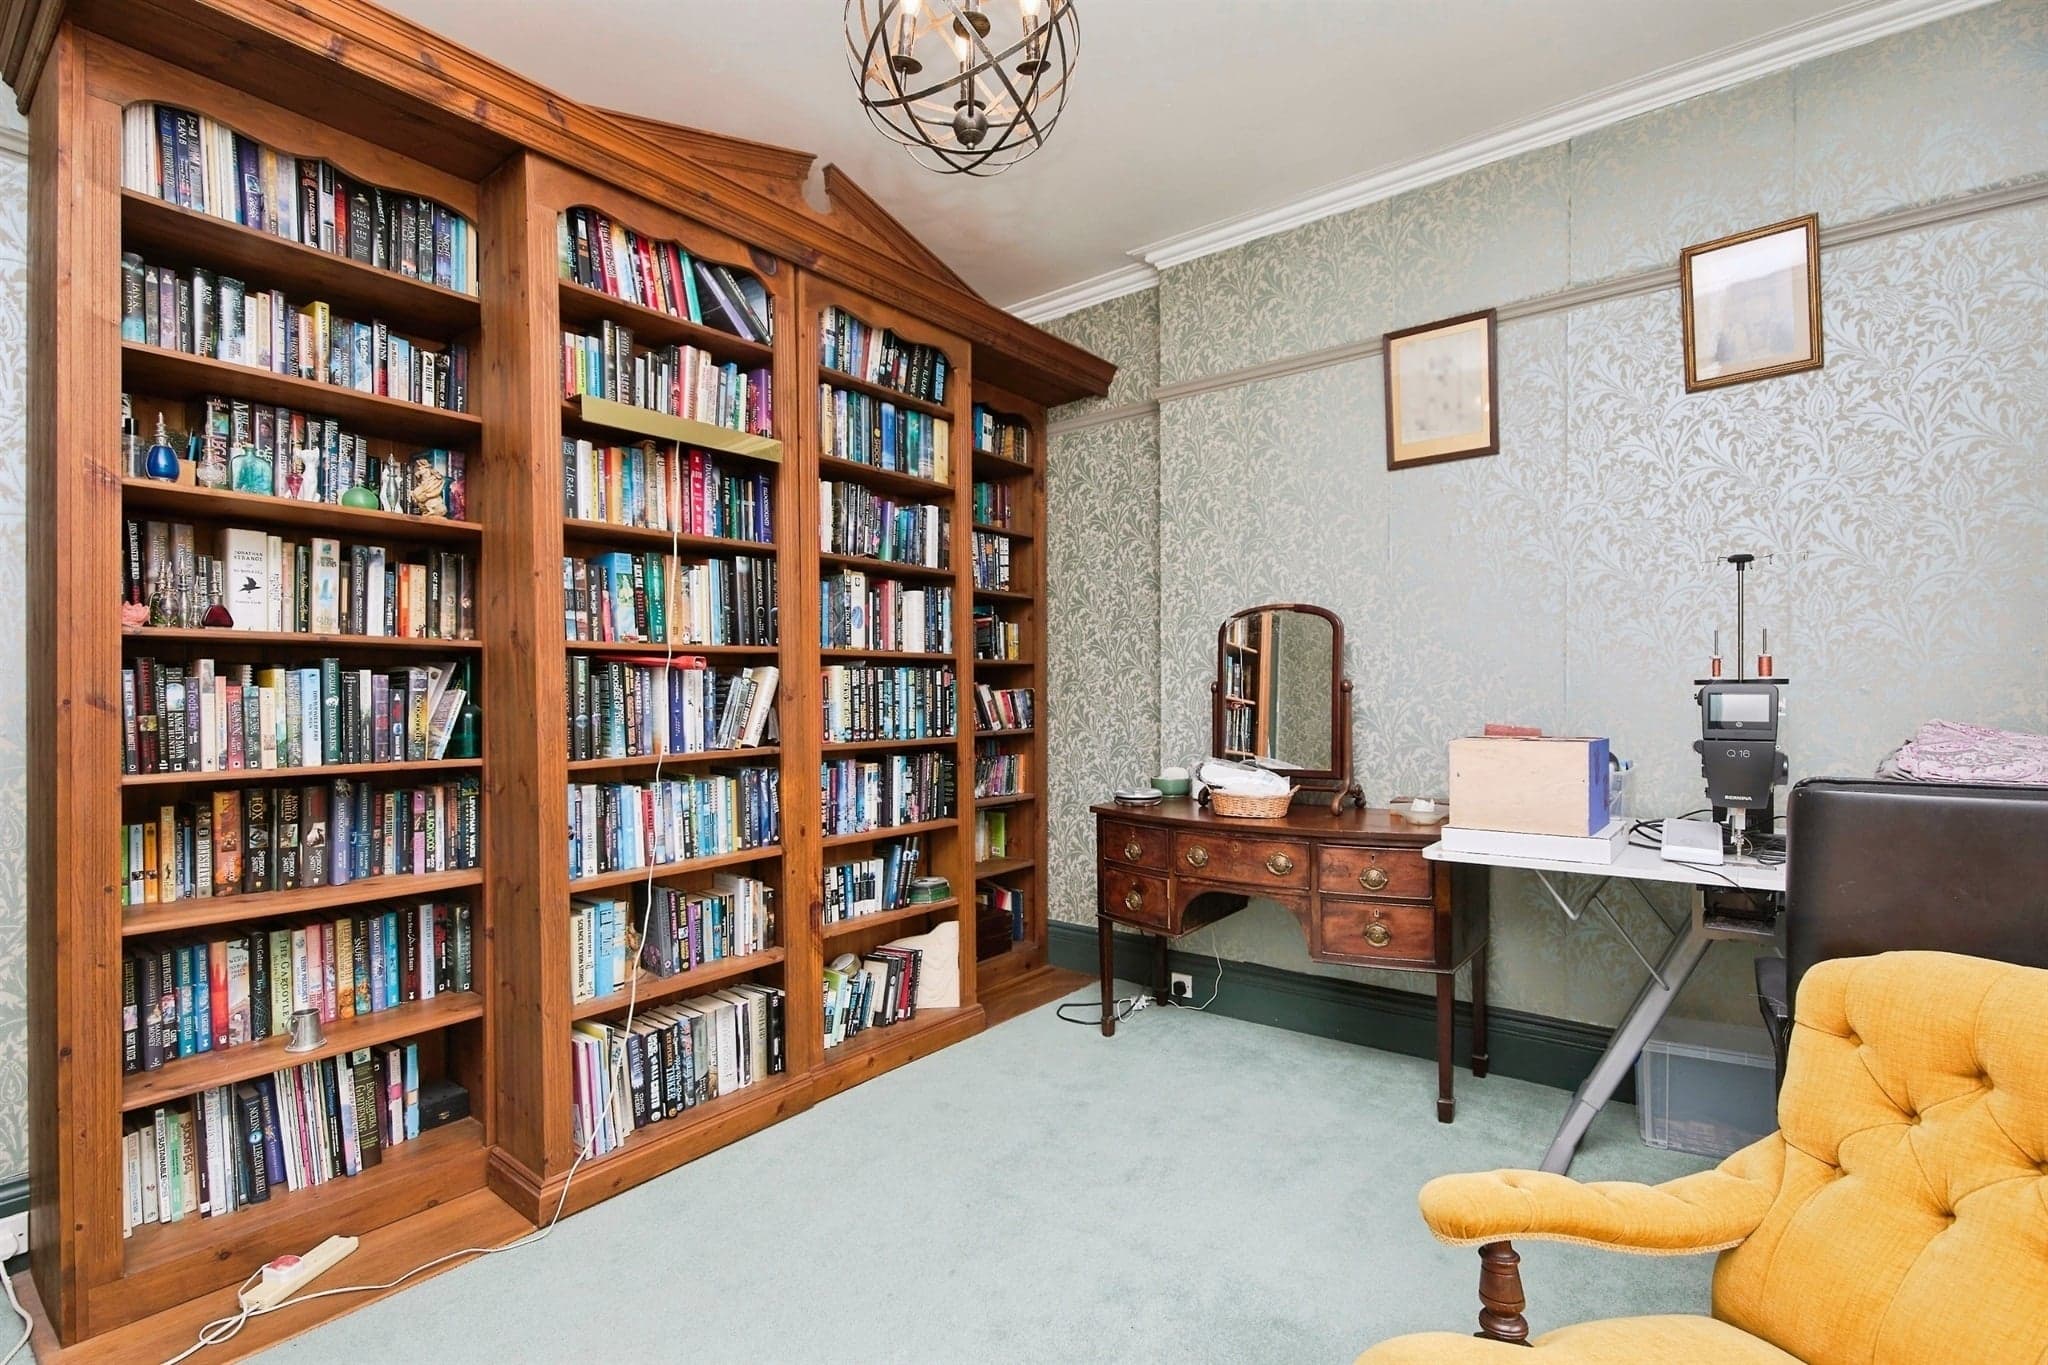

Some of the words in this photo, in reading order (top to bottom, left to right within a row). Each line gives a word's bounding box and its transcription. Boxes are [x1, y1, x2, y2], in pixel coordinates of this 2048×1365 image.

[210, 436, 226, 485] LEGAC
[612, 665, 620, 700] CHOOSERS
[745, 684, 756, 707] LOVECRAFT
[188, 689, 198, 712] Tooth
[188, 712, 198, 729] Fairy
[168, 730, 176, 760] HUNTER
[1726, 750, 1736, 758] Q
[1739, 750, 1750, 758] 16
[252, 796, 263, 820] FOX
[284, 795, 292, 821] SHIELD
[426, 810, 435, 852] BLACKWOOD
[198, 840, 210, 888] BONESHAKER
[280, 937, 288, 959] THE
[354, 938, 362, 962] SNUFF
[280, 961, 290, 1016] GARGOYLE
[666, 1068, 676, 1101] TINKER
[248, 1107, 260, 1132] NATION
[355, 1085, 366, 1132] GARDENING
[366, 1082, 376, 1128] ENCYCLOPEDIA
[158, 1136, 168, 1179] SUSTAINABLE
[253, 1144, 264, 1175] PRATCHETT
[256, 1176, 266, 1194] TERRY
